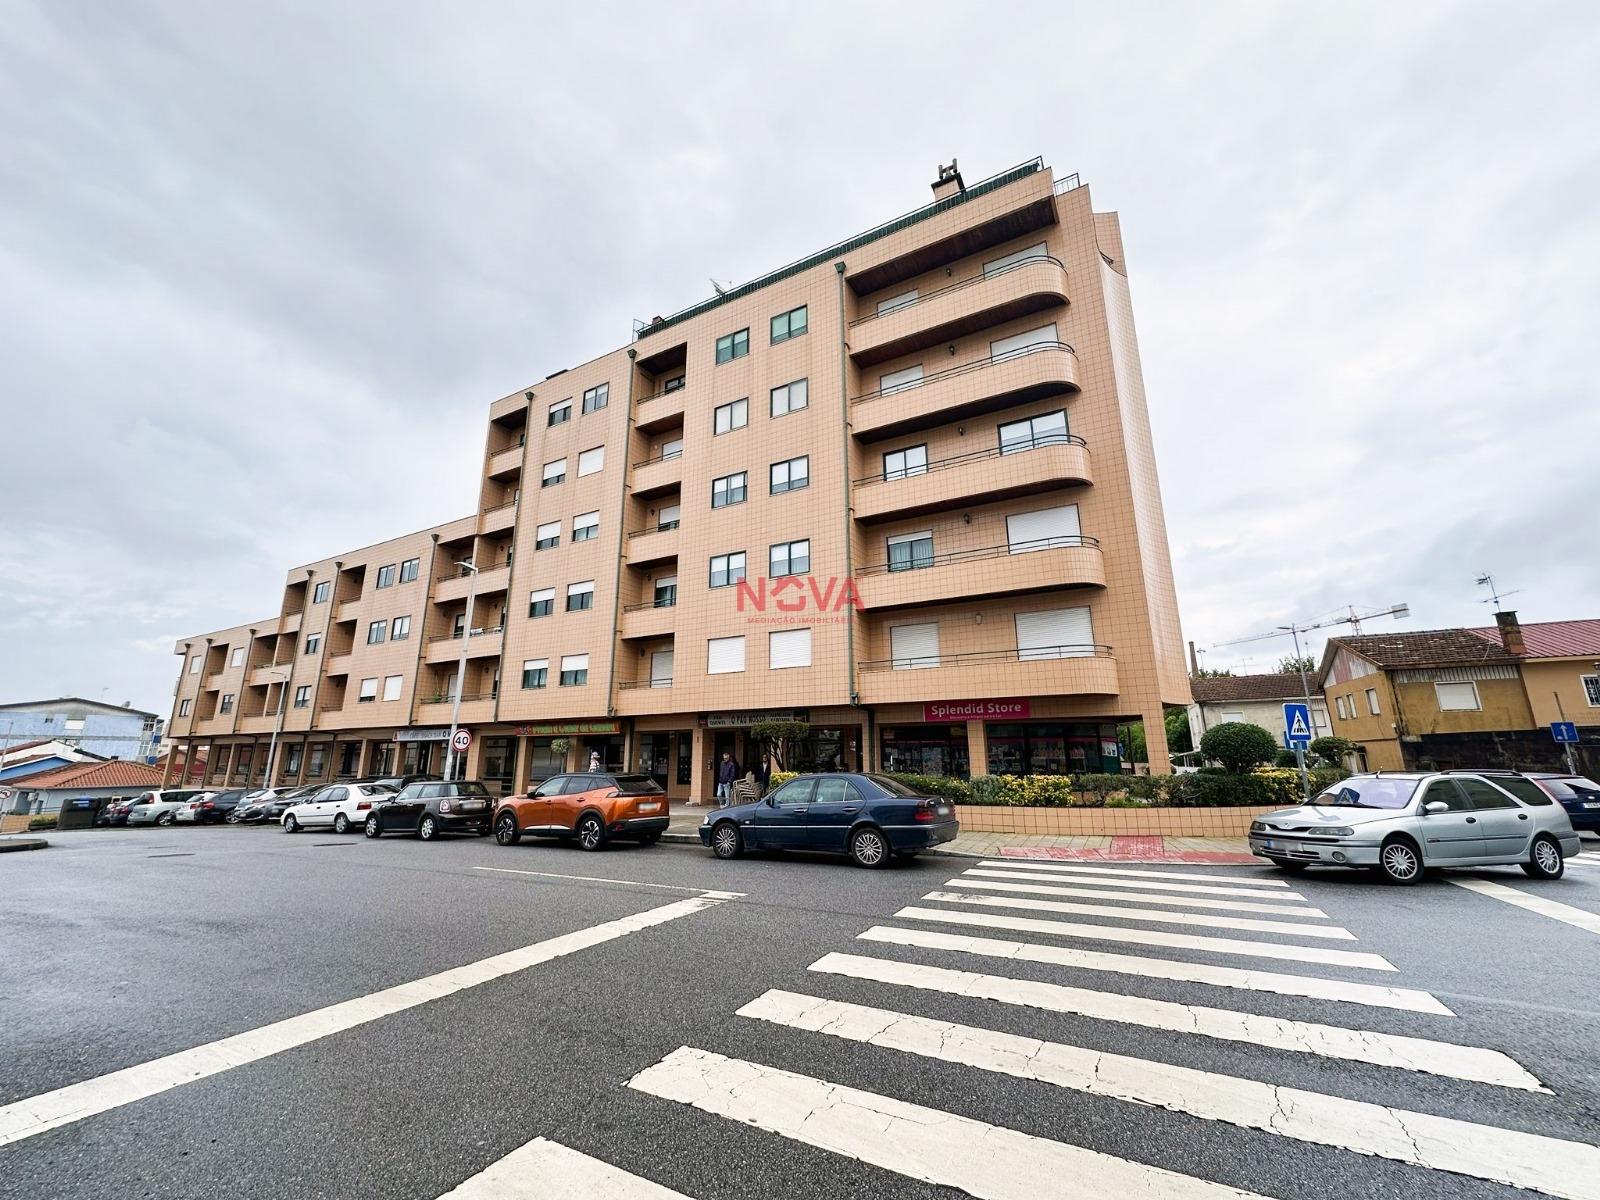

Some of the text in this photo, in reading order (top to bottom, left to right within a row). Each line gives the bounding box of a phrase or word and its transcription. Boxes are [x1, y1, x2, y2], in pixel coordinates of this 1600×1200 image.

[931, 704, 984, 718] Splendid
[987, 703, 1022, 713] Store
[455, 736, 468, 744] 40
